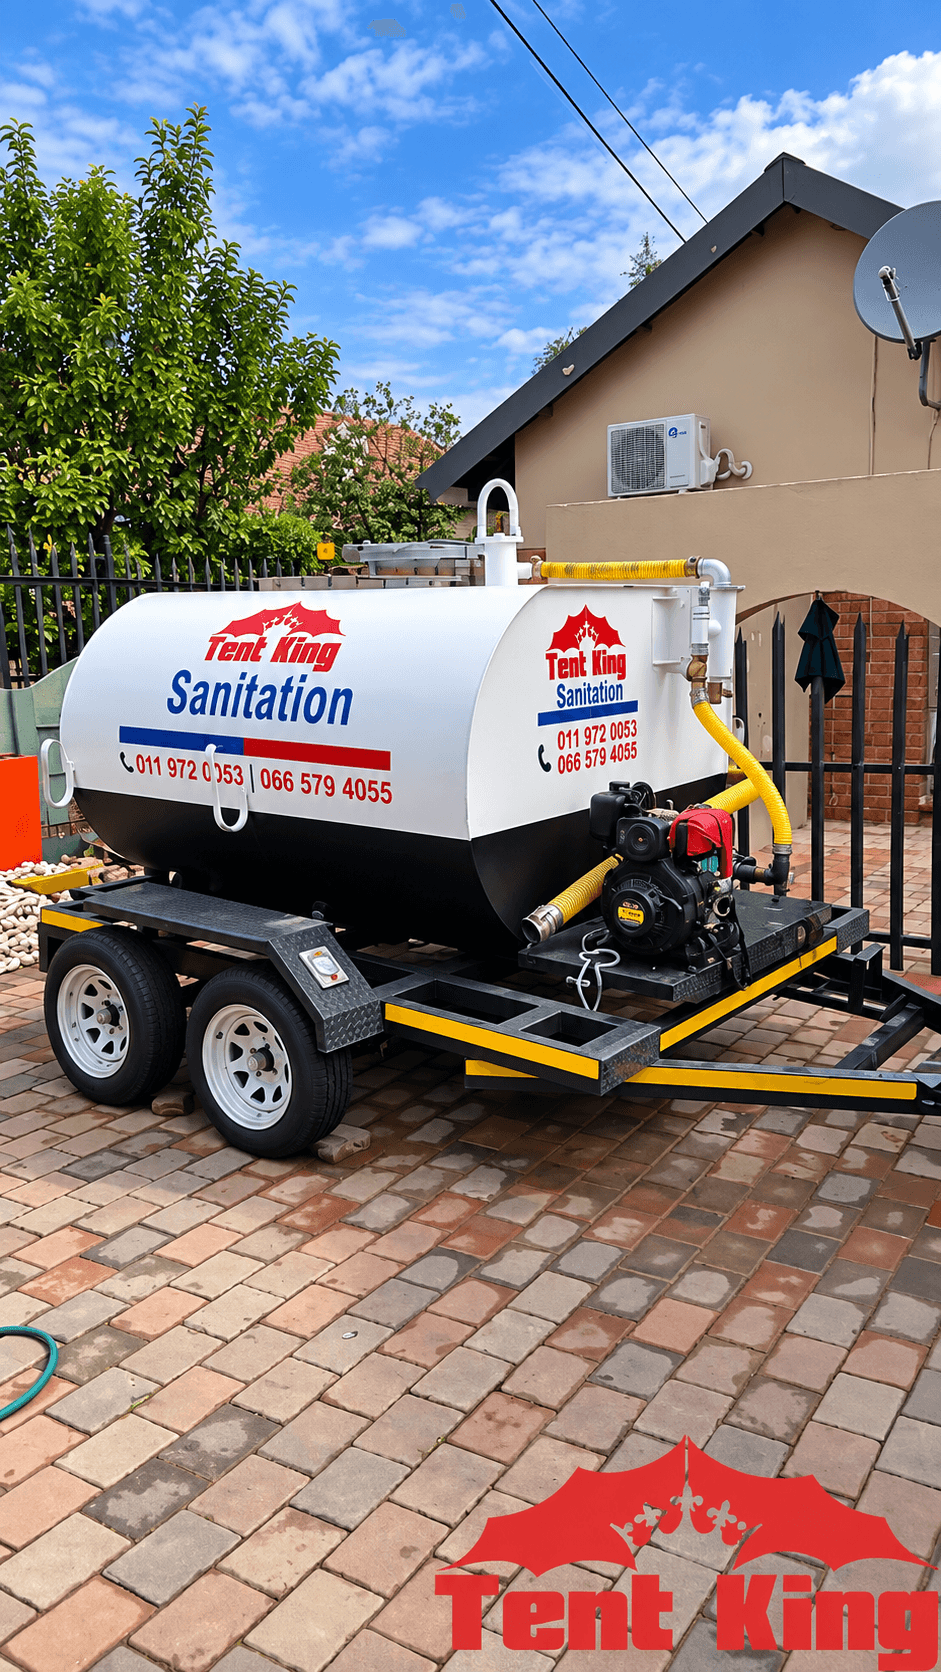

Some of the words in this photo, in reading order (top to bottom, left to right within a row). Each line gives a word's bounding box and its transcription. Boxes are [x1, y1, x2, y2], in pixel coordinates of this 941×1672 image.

[204, 636, 268, 662] Tent
[270, 637, 342, 672] King
[545, 651, 587, 680] Tent
[592, 649, 626, 681] King
[167, 669, 353, 726] Sanitation
[556, 680, 623, 708] Sanitation
[558, 728, 579, 750] 011
[584, 724, 606, 746] 972
[610, 719, 637, 741] 0053
[558, 752, 581, 774] 066
[585, 747, 606, 769] 579
[610, 741, 637, 763] 4055
[136, 754, 161, 776] 011
[167, 757, 197, 780] 972
[260, 768, 294, 792] 066
[301, 773, 335, 797] 579
[342, 777, 392, 804] 4055
